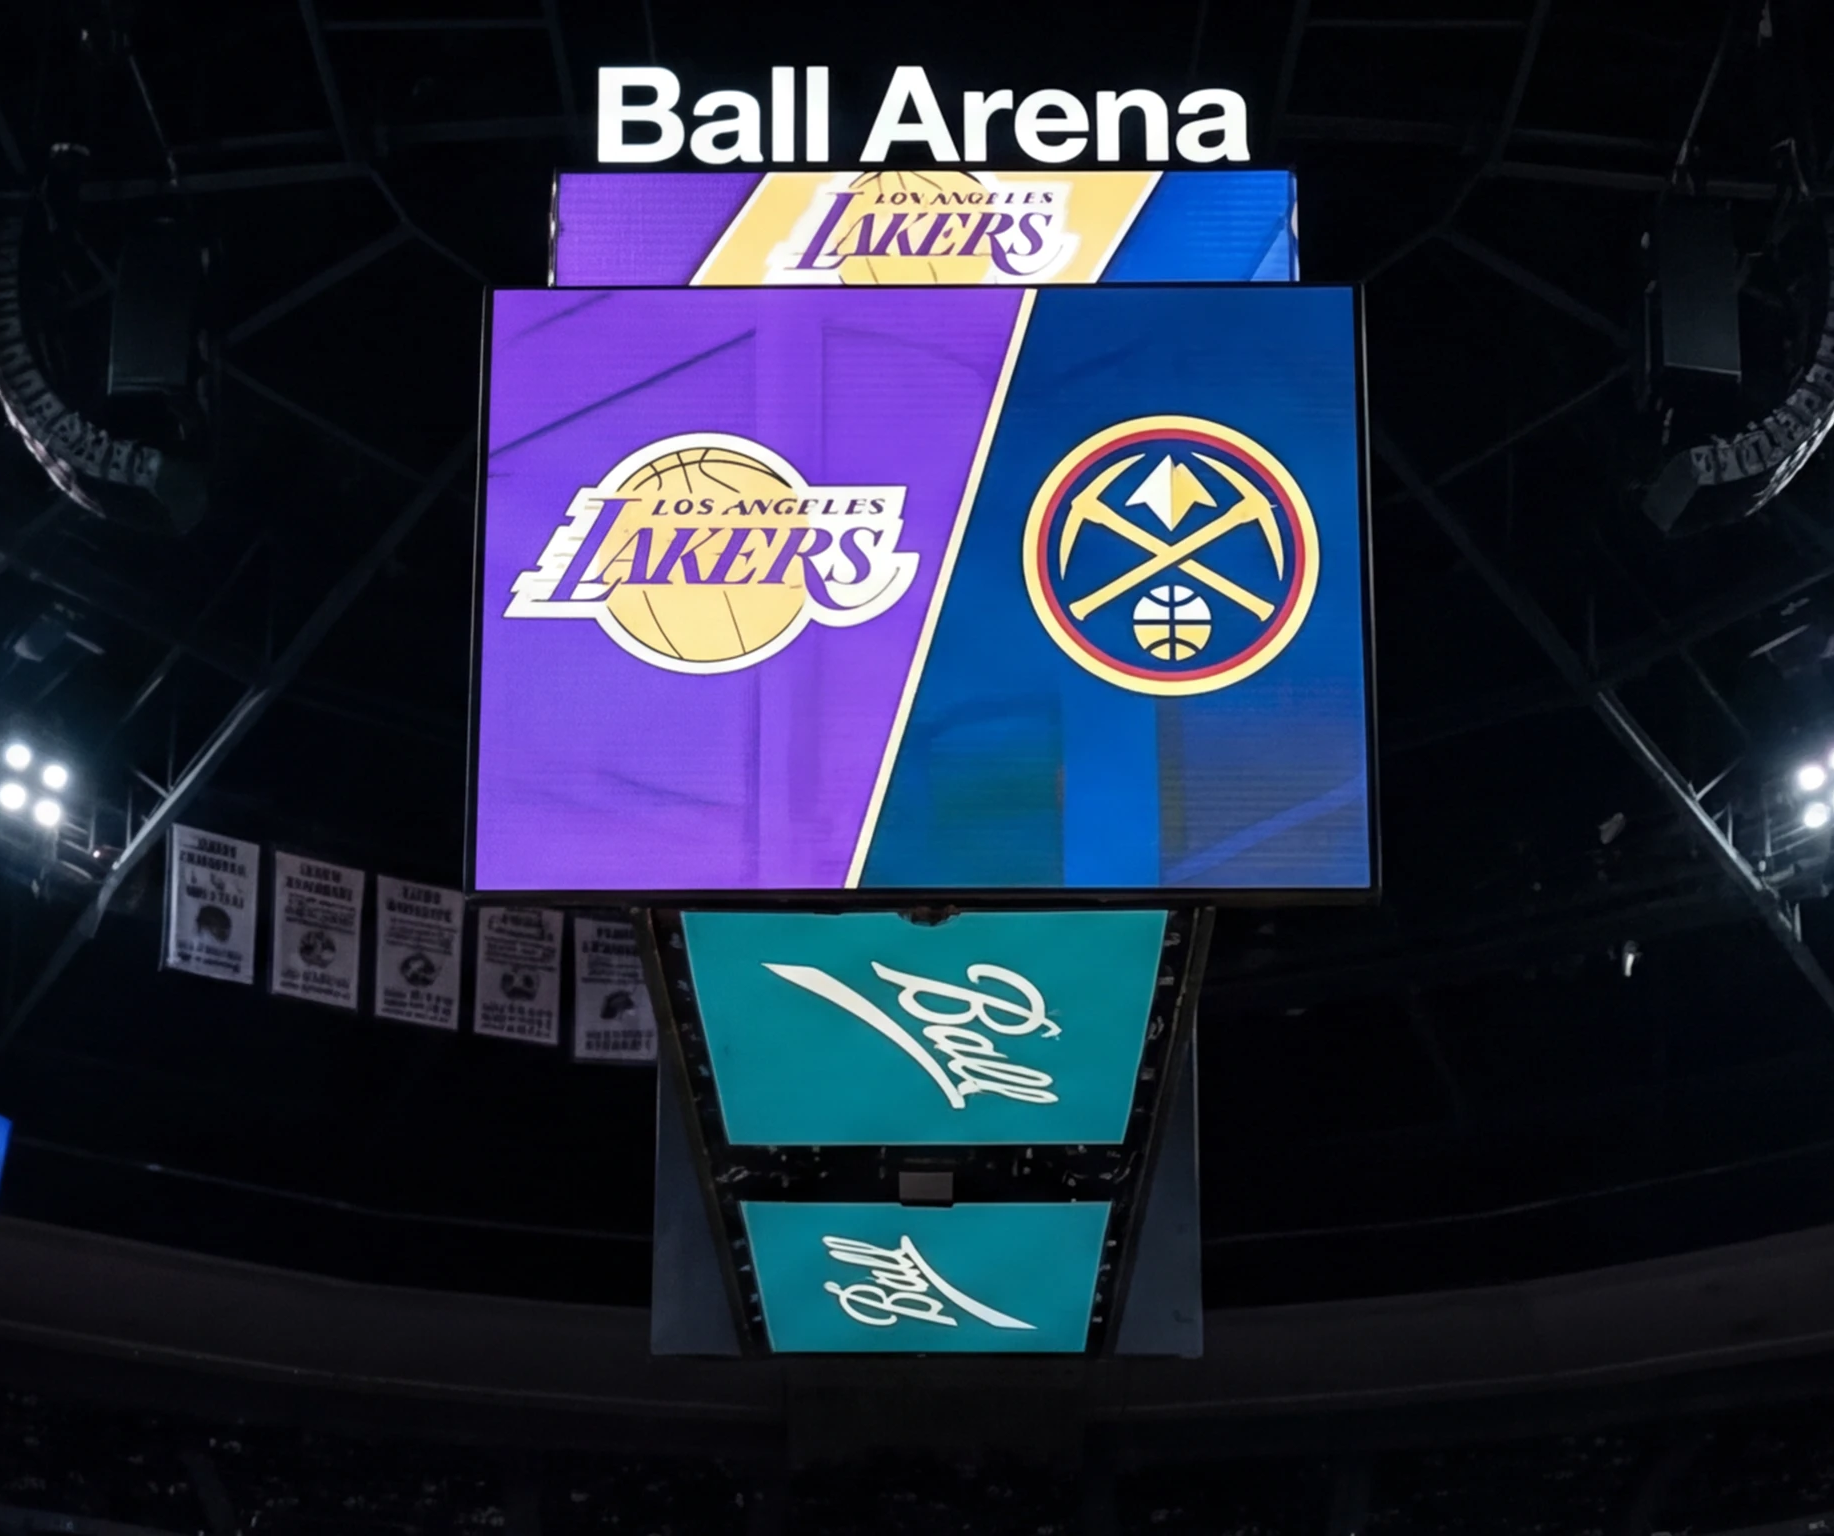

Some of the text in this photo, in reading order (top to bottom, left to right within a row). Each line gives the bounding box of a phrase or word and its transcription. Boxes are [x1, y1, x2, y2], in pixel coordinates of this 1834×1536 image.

[597, 65, 1252, 165] Ball Arena
[784, 191, 1055, 276] LAKERS
[651, 498, 887, 517] LOS ANGELES
[532, 498, 887, 612] LAKERS
